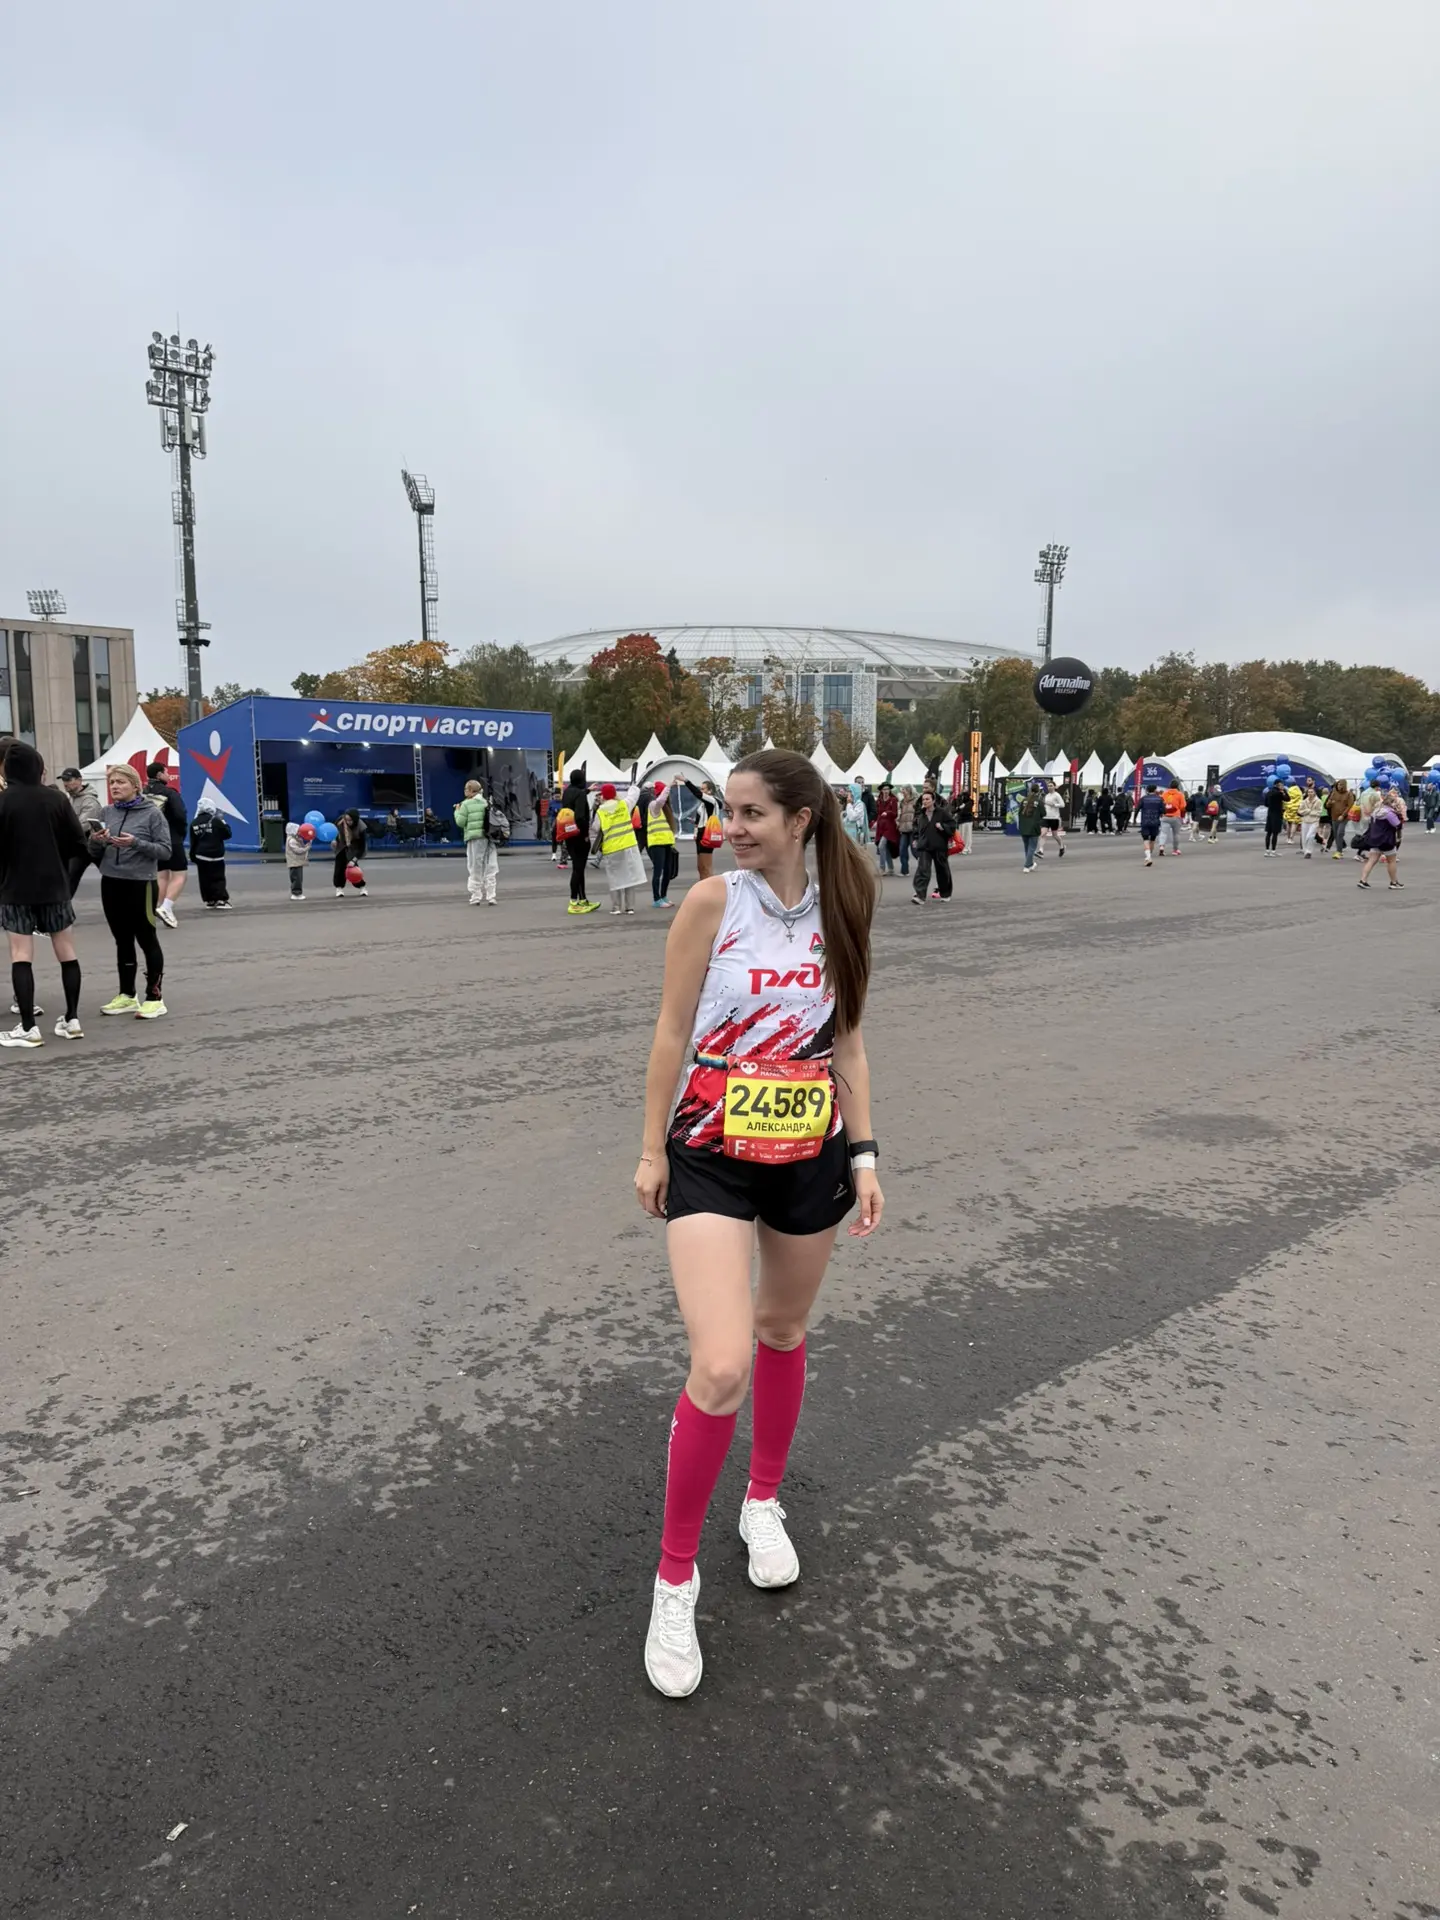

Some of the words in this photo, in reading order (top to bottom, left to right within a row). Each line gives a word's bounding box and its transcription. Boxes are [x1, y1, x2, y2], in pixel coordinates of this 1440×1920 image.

[1039, 674, 1091, 693] Adrenaline
[336, 712, 514, 741] спортмастер
[729, 1084, 826, 1119] 24589
[746, 1121, 812, 1133] АЛЕКСАНДРА
[735, 1139, 748, 1155] F
